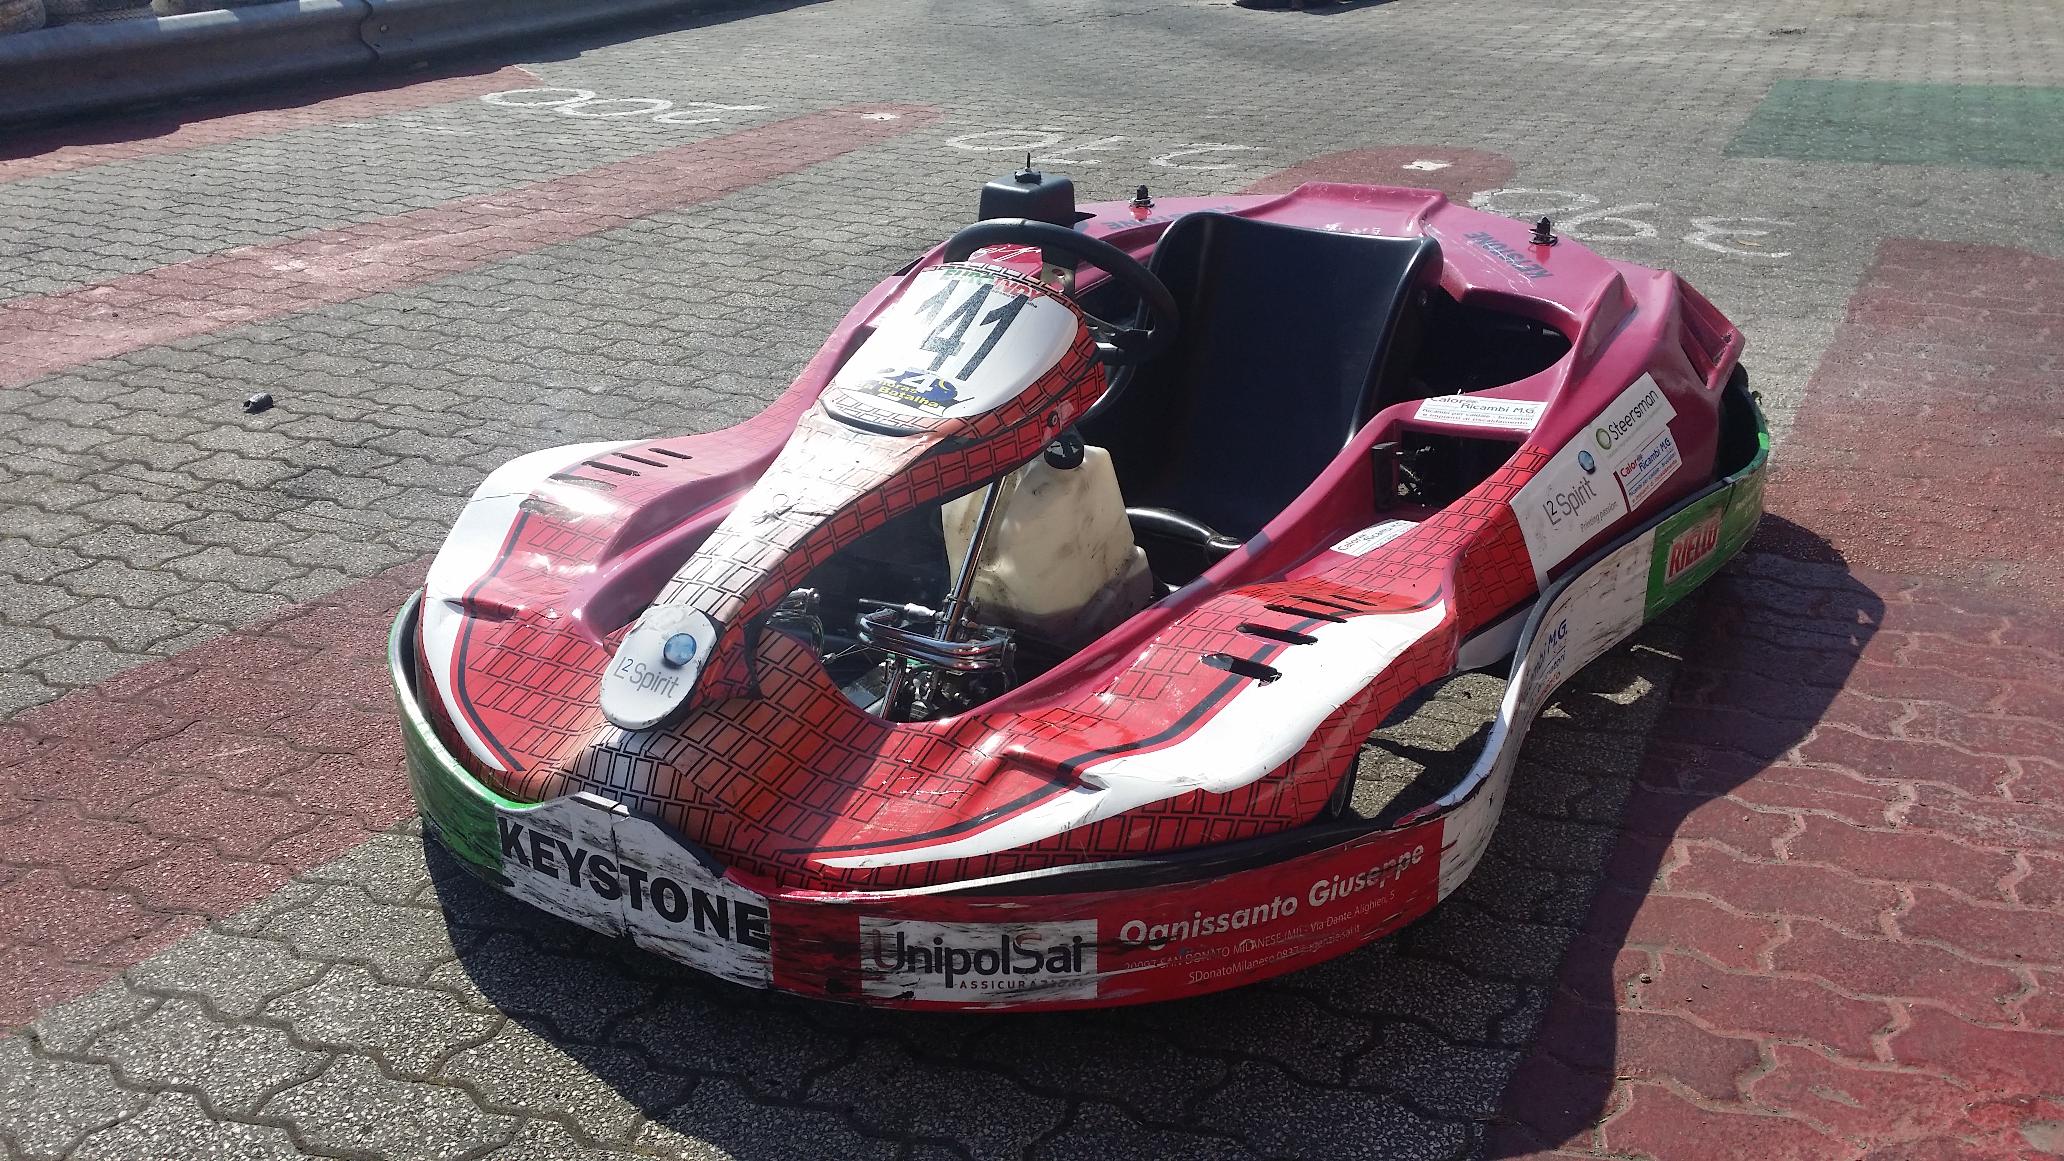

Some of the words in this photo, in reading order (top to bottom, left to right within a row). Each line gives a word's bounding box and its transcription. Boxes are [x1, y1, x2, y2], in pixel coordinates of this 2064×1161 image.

[913, 279, 1030, 382] 141
[878, 385, 940, 408] Batalha
[1460, 402, 1510, 413] Ricambi
[1608, 388, 1659, 441] Steersman
[1620, 459, 1638, 477] Calor
[1639, 448, 1661, 472] Ricambi
[498, 816, 771, 952] KEYSTONE
[1119, 895, 1299, 951] Ognissanto
[1308, 842, 1425, 908] Giuseppe
[872, 928, 1083, 988] UnipolSai
